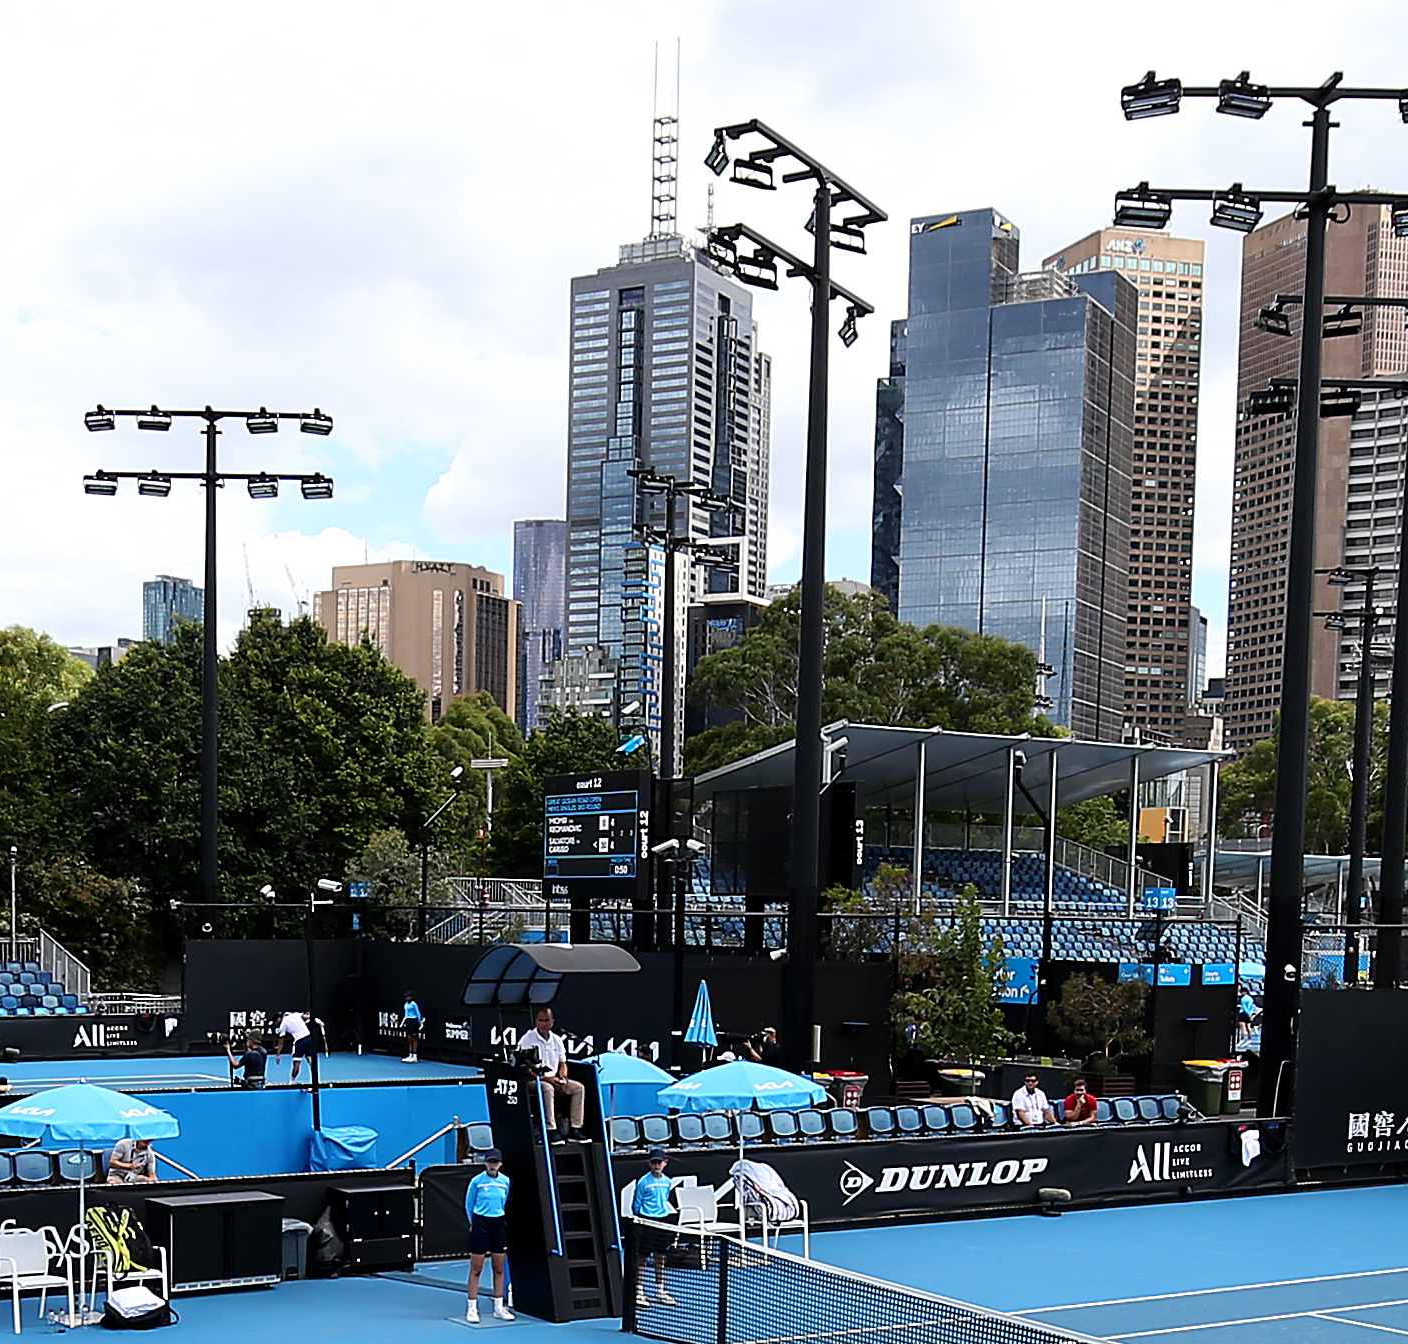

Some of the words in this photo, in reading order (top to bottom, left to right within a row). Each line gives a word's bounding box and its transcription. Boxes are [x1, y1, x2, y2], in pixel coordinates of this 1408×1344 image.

[911, 223, 925, 234] EY
[494, 1079, 518, 1095] ATP
[1127, 1142, 1171, 1184] All
[1173, 1144, 1202, 1153] ACCOR
[1172, 1157, 1190, 1167] LIVE
[875, 1157, 1049, 1193] DUNLOP
[1172, 1168, 1213, 1180] LIMITLESS
